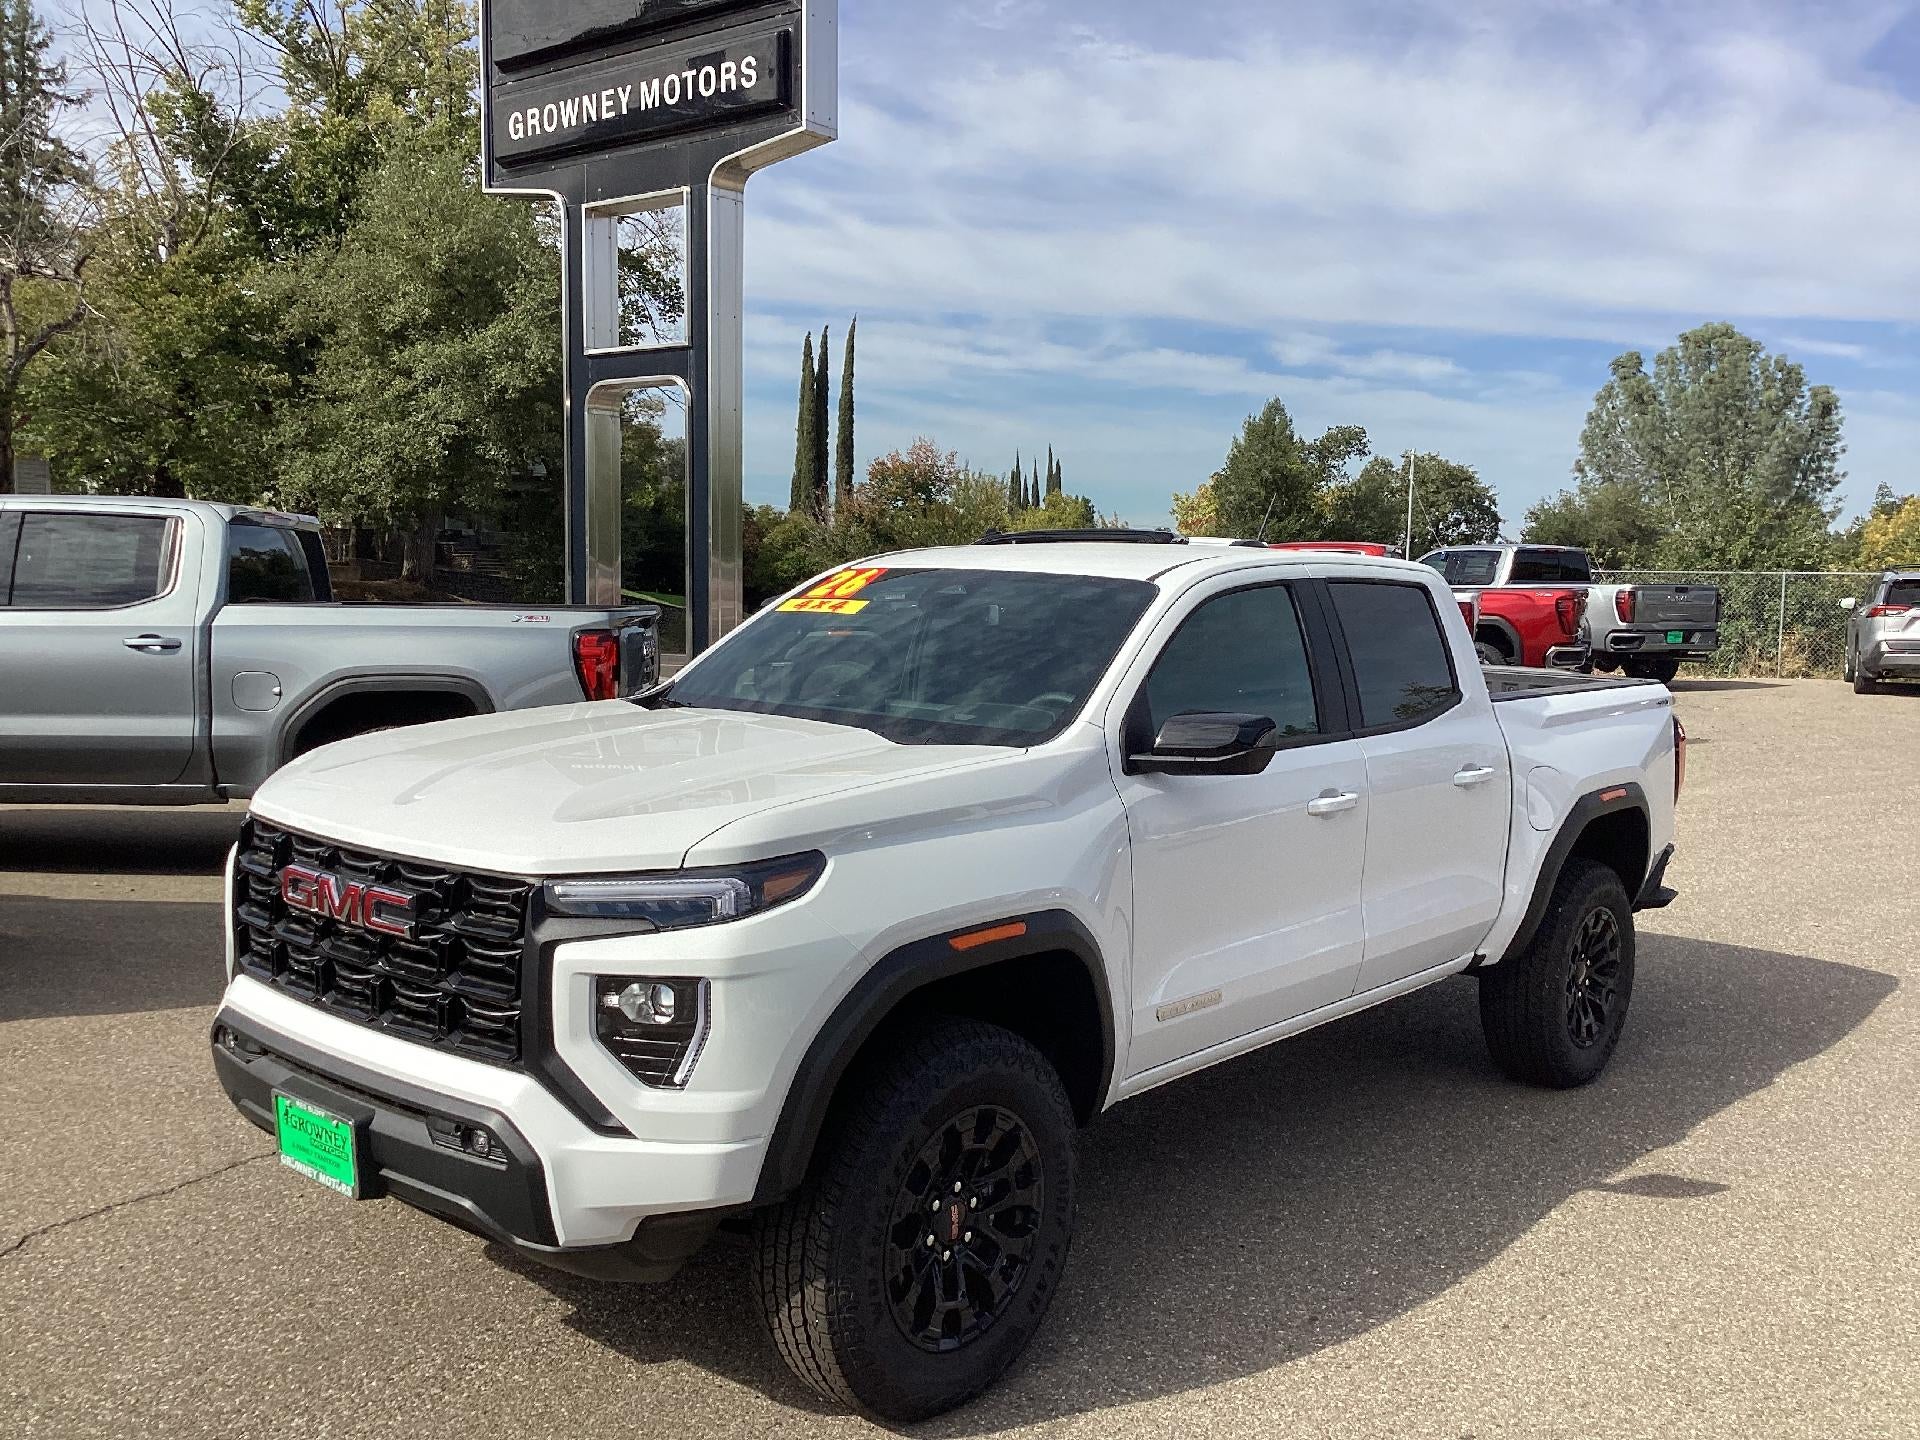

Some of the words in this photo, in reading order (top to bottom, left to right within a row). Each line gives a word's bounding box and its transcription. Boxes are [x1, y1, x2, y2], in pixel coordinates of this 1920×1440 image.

[508, 85, 632, 140] GROWNEY
[639, 56, 758, 111] MOTORS
[805, 569, 879, 596] 26
[281, 864, 415, 938] GMC
[290, 1113, 347, 1152] GROWNEY
[280, 1154, 319, 1180] GROWNEY
[319, 1170, 353, 1198] MOTORS
